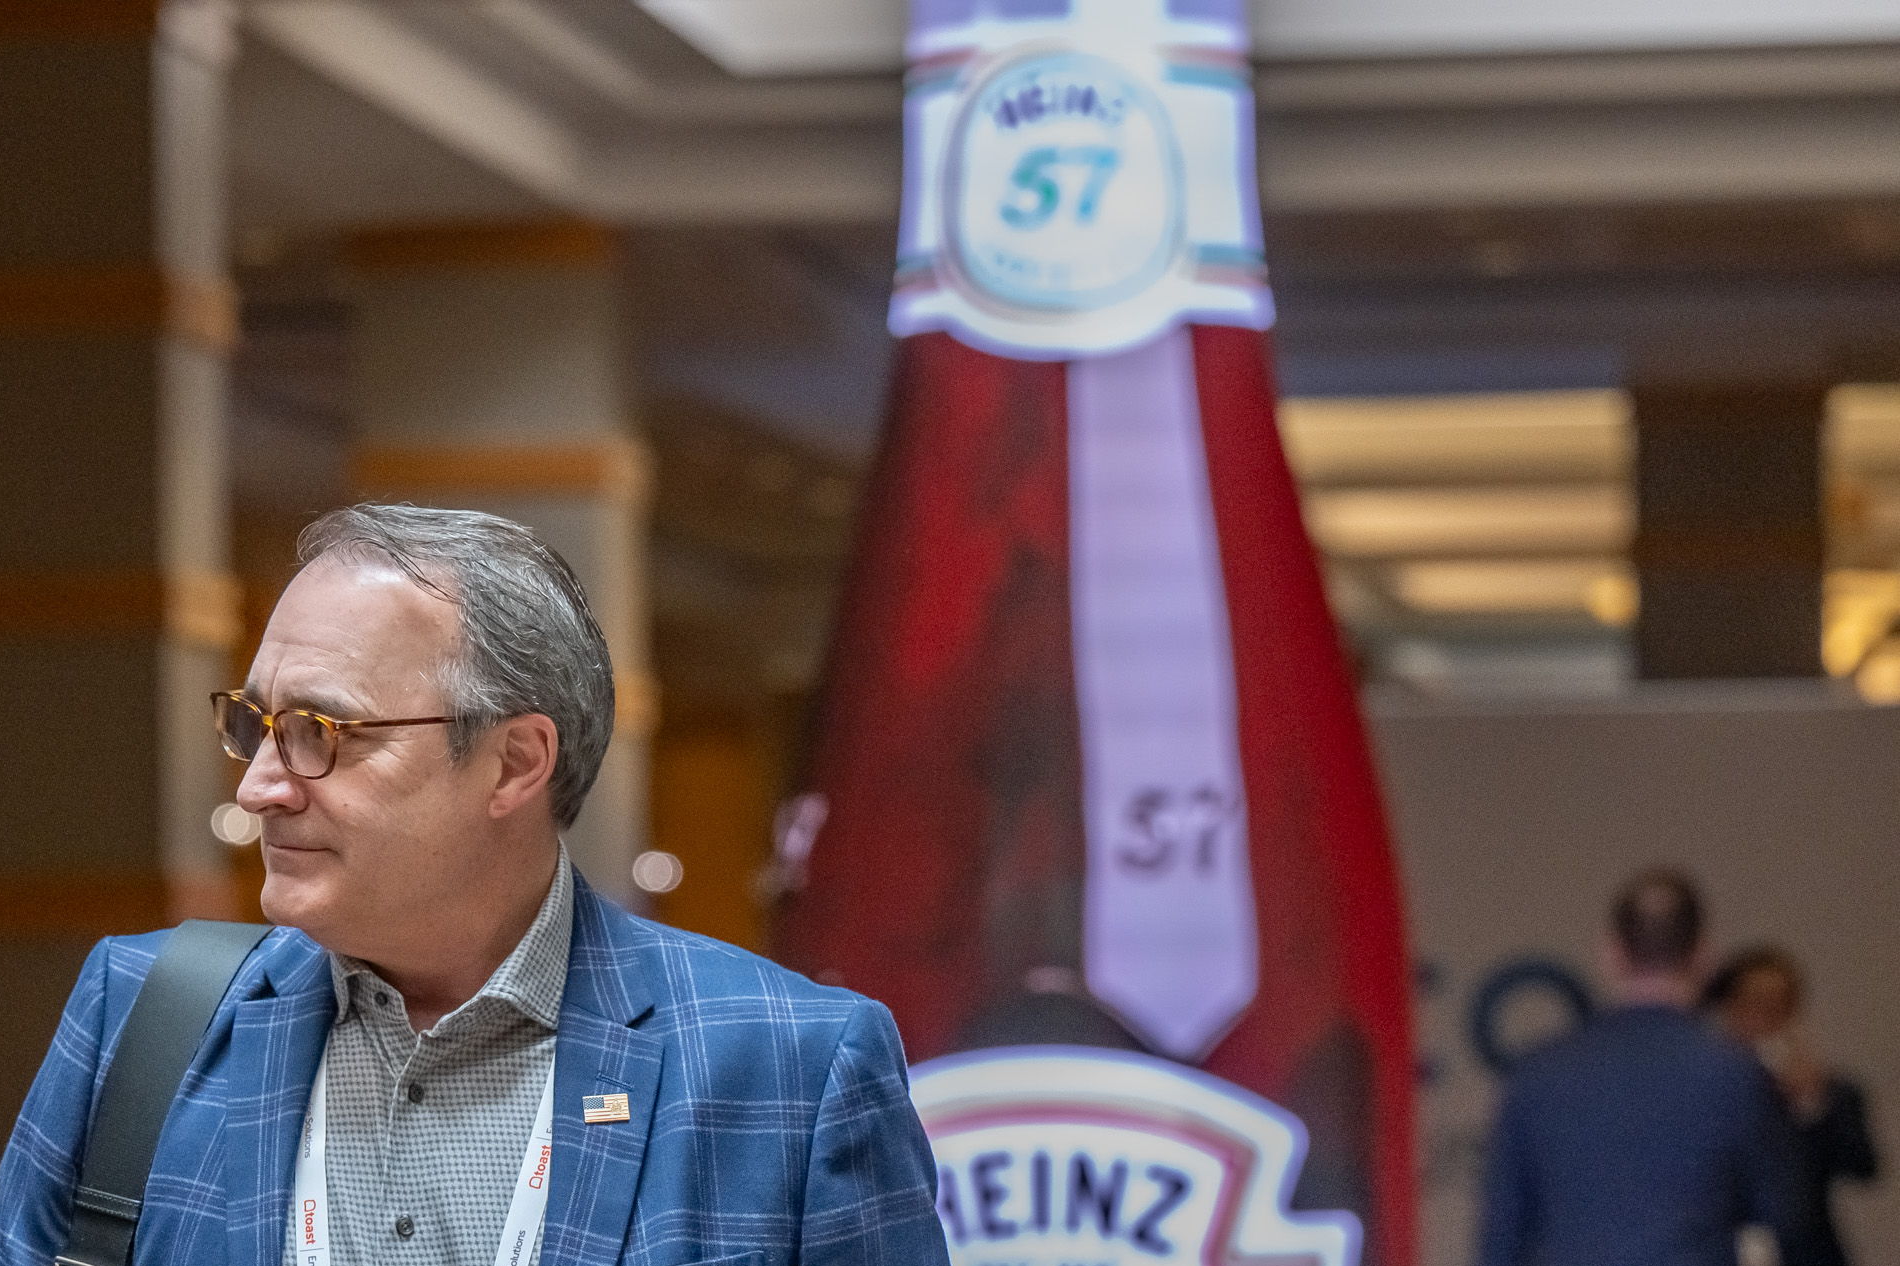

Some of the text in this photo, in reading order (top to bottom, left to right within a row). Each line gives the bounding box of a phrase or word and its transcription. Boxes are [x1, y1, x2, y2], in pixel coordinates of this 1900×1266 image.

[998, 147, 1121, 231] 57
[1113, 785, 1238, 878] 57
[304, 1117, 314, 1159] Solutions
[534, 1145, 552, 1176] toast
[304, 1212, 316, 1245] toast
